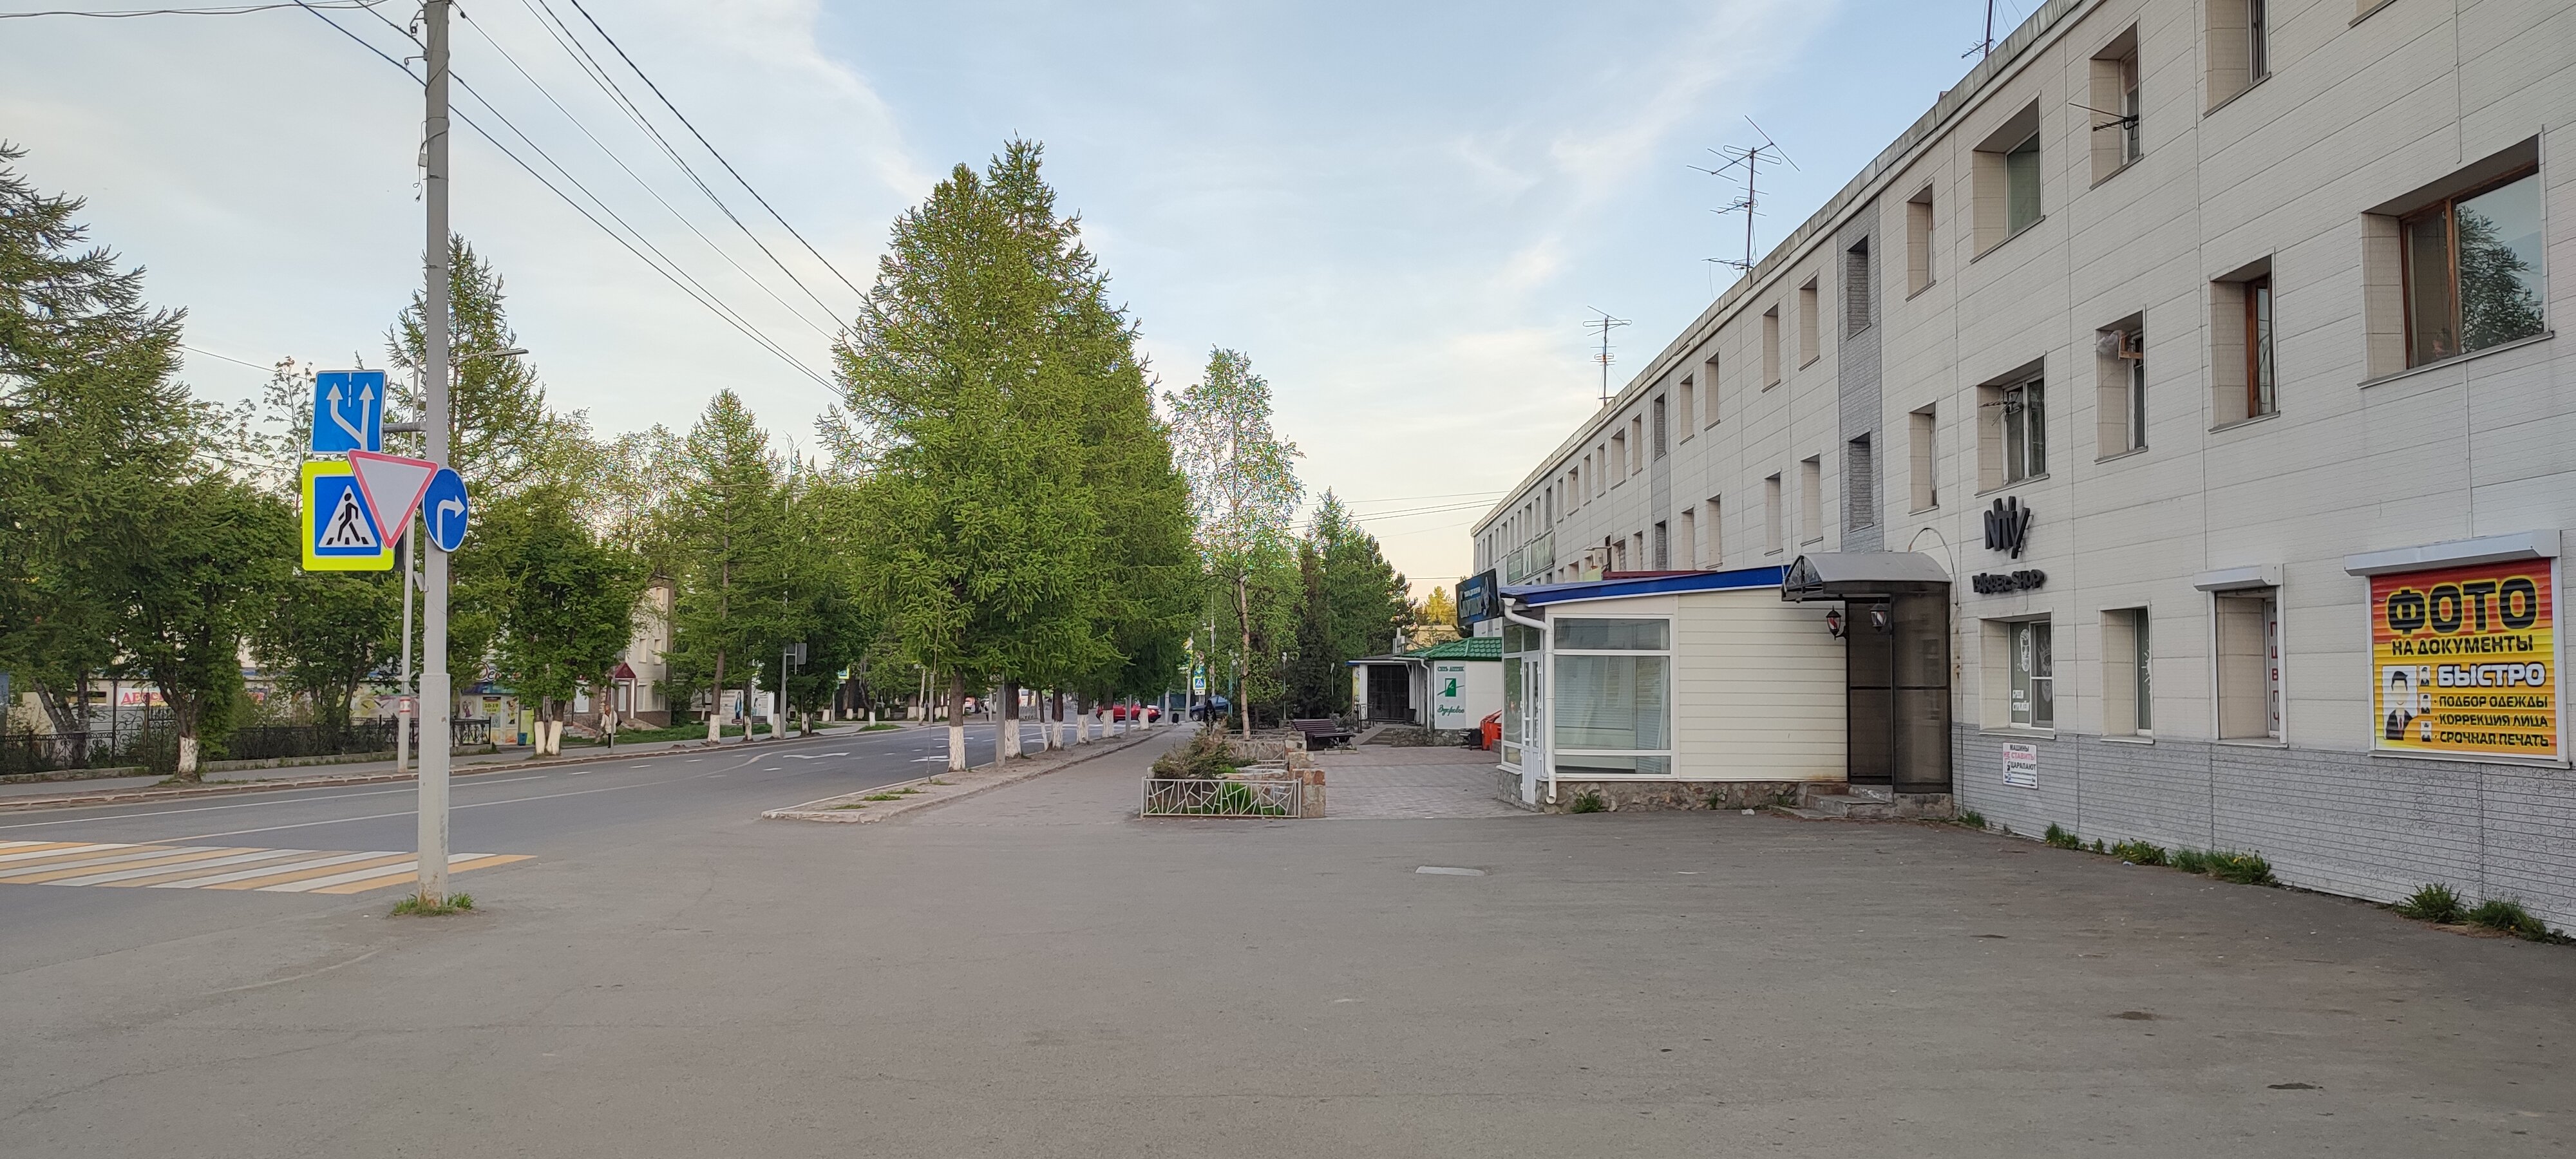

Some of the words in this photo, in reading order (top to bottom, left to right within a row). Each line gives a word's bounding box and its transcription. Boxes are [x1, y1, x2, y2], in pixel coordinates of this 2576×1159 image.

[2387, 578, 2537, 635] ФОТО
[2392, 639, 2414, 655] НА
[2417, 634, 2533, 655] ДОКУМЕНТЫ
[2437, 662, 2546, 687] БЫСТРО
[2439, 696, 2487, 708] ПОДБОР
[2489, 696, 2548, 708] ОДЕЖДЫ
[2439, 714, 2510, 727] КОРРЕКЦИЯ
[2512, 715, 2548, 728] ЛИЦА
[2439, 731, 2497, 745] СРОЧНАЯ
[2499, 733, 2549, 747] ПЕЧАТЬ
[2011, 761, 2036, 771] ЦАРАПАЮТ
